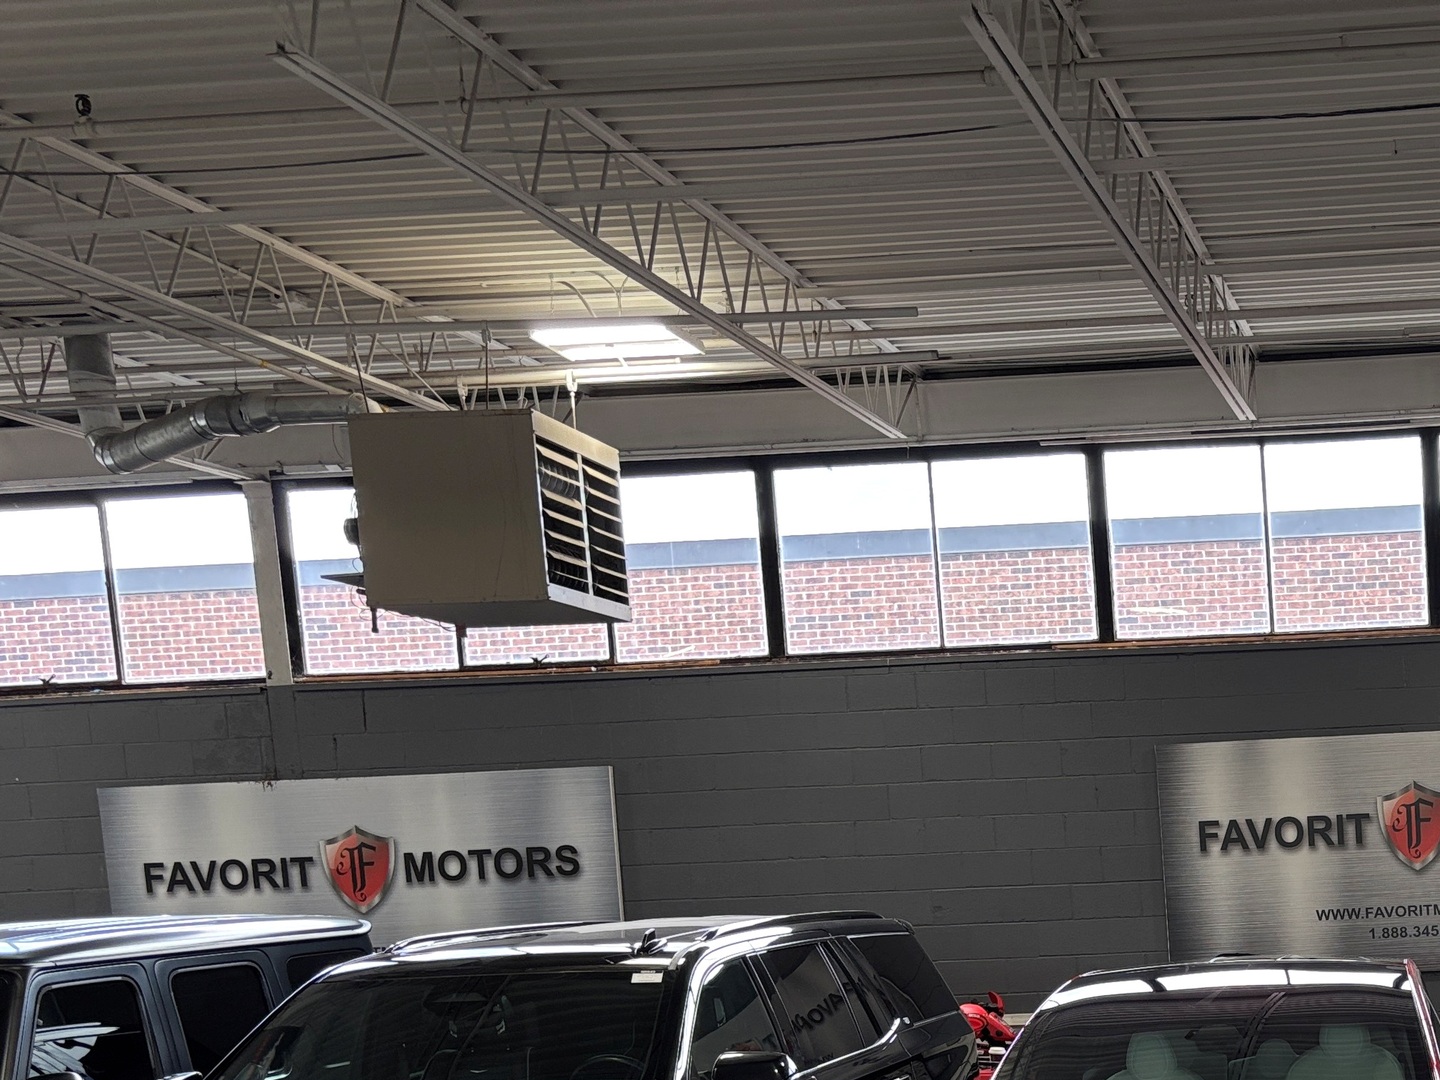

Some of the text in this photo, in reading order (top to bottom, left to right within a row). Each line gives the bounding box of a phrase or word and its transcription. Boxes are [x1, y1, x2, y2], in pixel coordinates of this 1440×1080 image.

[1198, 813, 1371, 853] FAVORIT
[143, 856, 314, 894] FAVORIT
[403, 844, 580, 883] MOTORS
